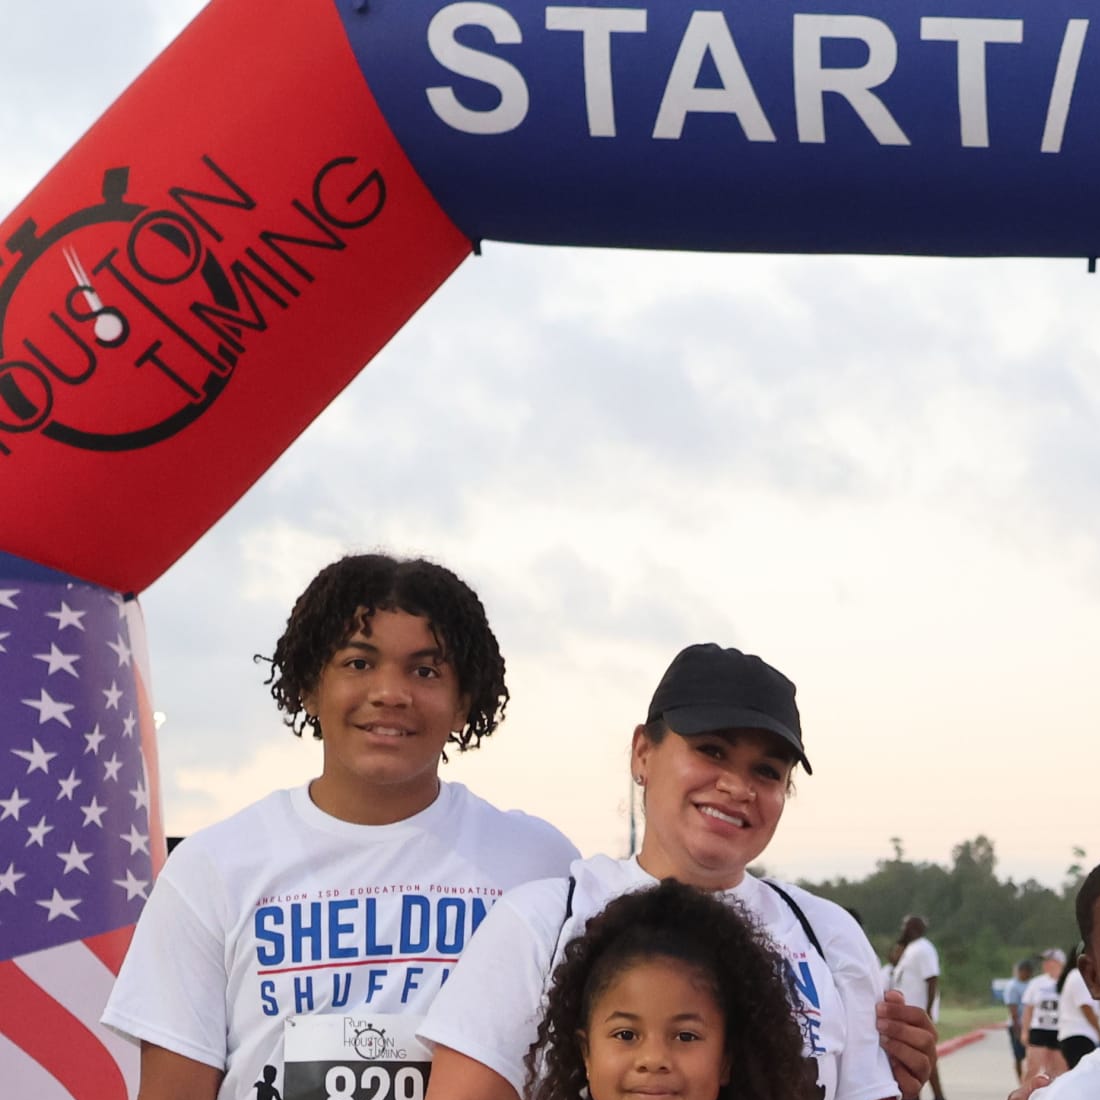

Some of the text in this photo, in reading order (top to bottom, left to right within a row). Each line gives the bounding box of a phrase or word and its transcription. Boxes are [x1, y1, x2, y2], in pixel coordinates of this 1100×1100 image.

[0, 153, 257, 456] OUSTON
[134, 155, 387, 402] TIMING
[317, 889, 340, 899] ISD
[350, 884, 421, 896] EDUCATION
[429, 884, 503, 897] FOUNDATION
[343, 1036, 395, 1048] HOUSTON
